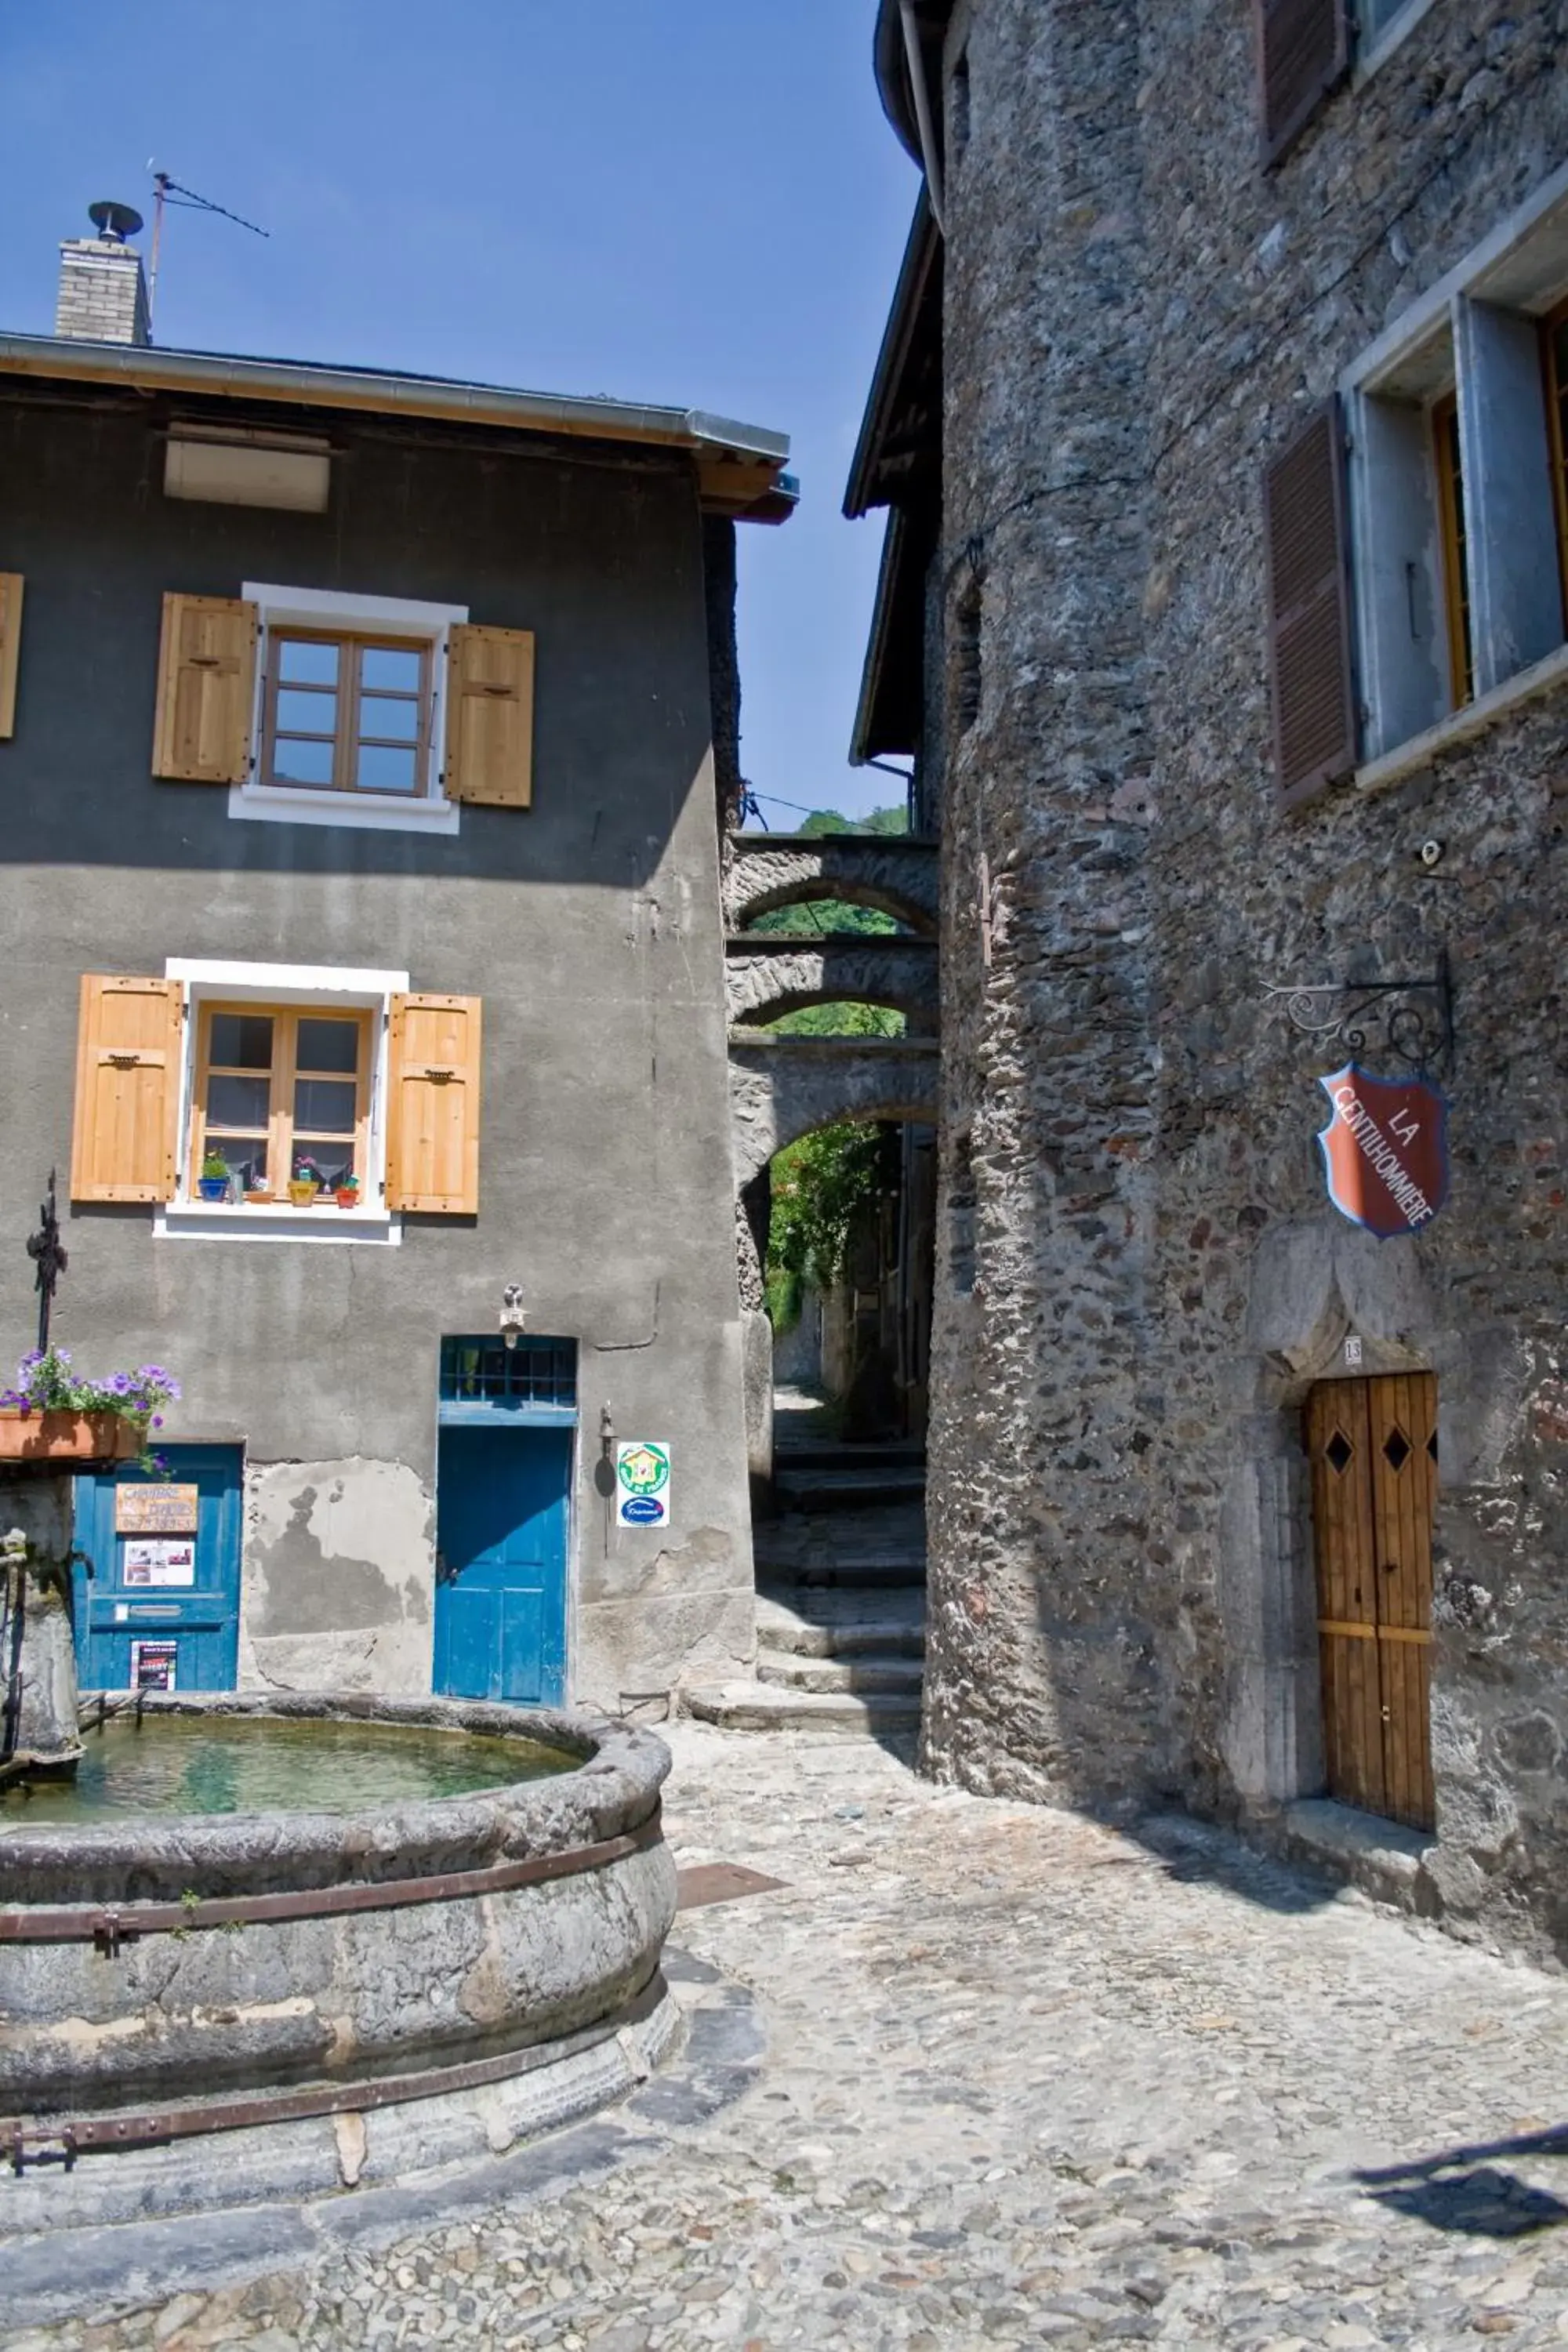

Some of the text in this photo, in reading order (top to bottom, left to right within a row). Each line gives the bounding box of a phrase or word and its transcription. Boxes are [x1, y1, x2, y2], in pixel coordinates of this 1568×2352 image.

[1388, 1108, 1421, 1147] LA
[1334, 1087, 1434, 1226] GENTILHOMMIÈRE
[1347, 1342, 1360, 1358] 13
